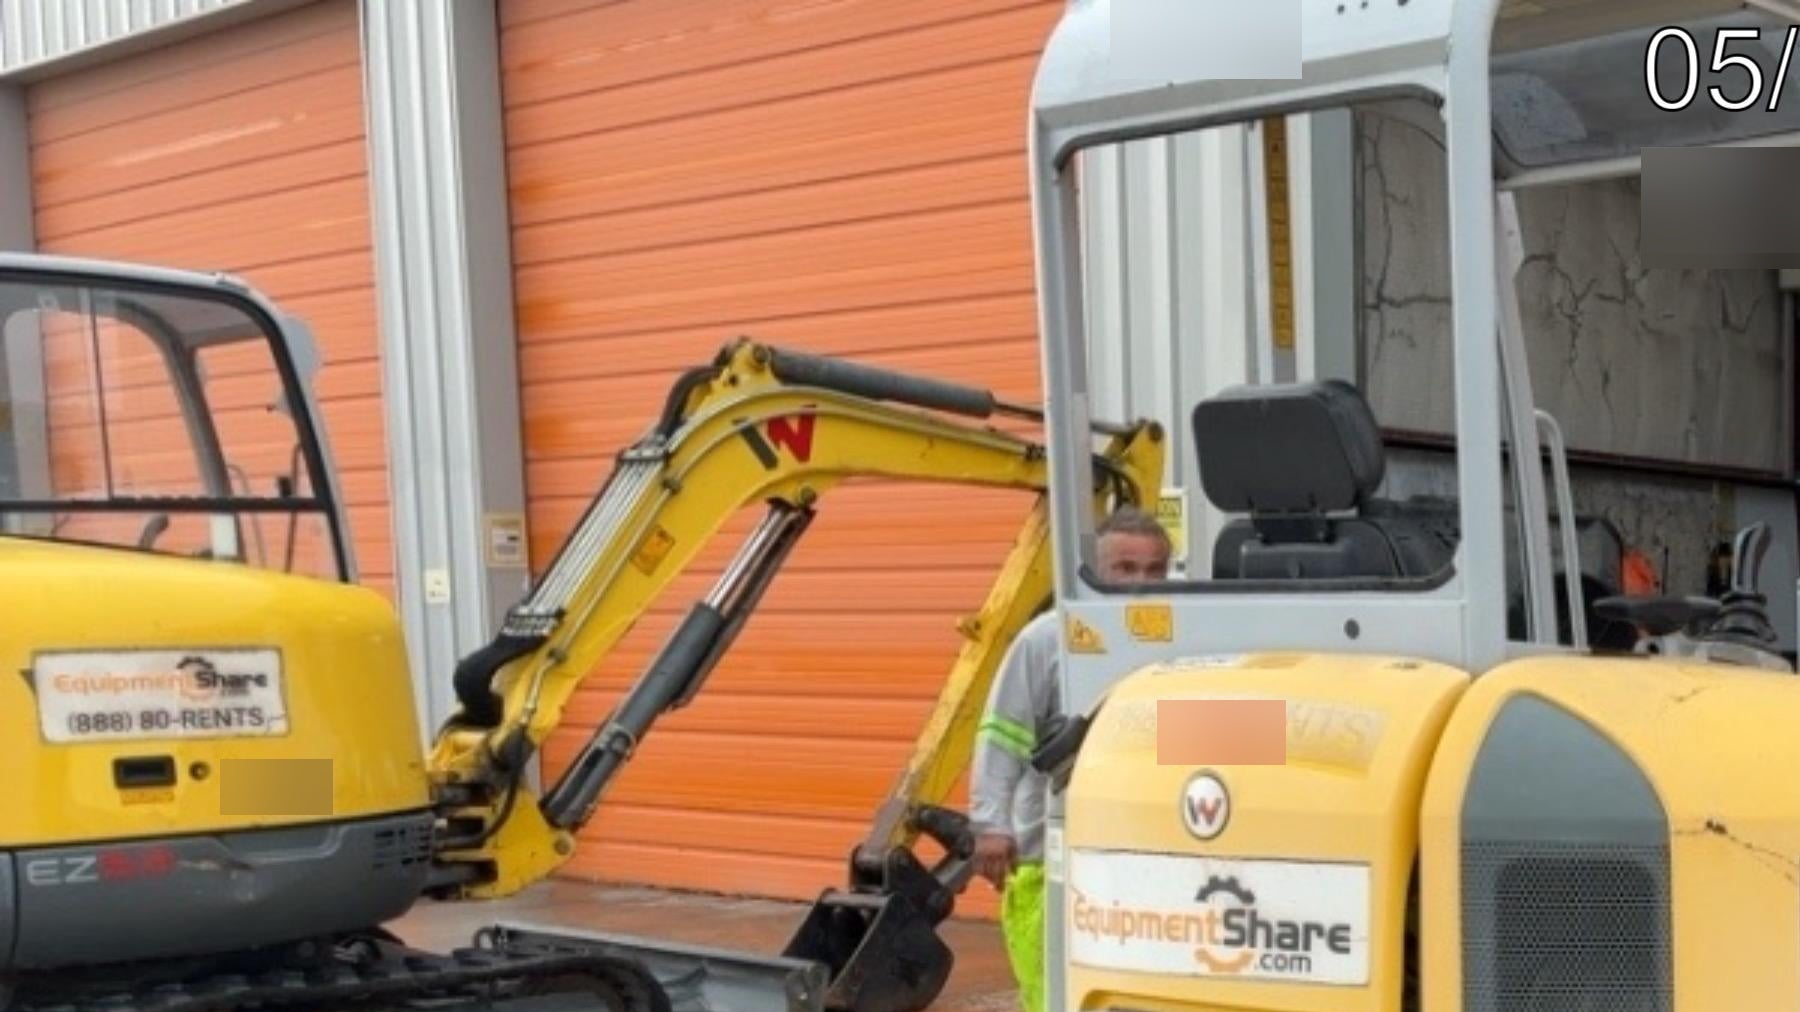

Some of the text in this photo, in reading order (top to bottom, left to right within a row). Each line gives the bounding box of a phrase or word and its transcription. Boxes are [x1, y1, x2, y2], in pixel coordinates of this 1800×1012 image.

[53, 670, 268, 696] EquipmentShare
[67, 707, 265, 735] (888) 80-RENTS
[1071, 893, 1352, 954] EquipmentShare
[1253, 951, 1312, 974] .com
